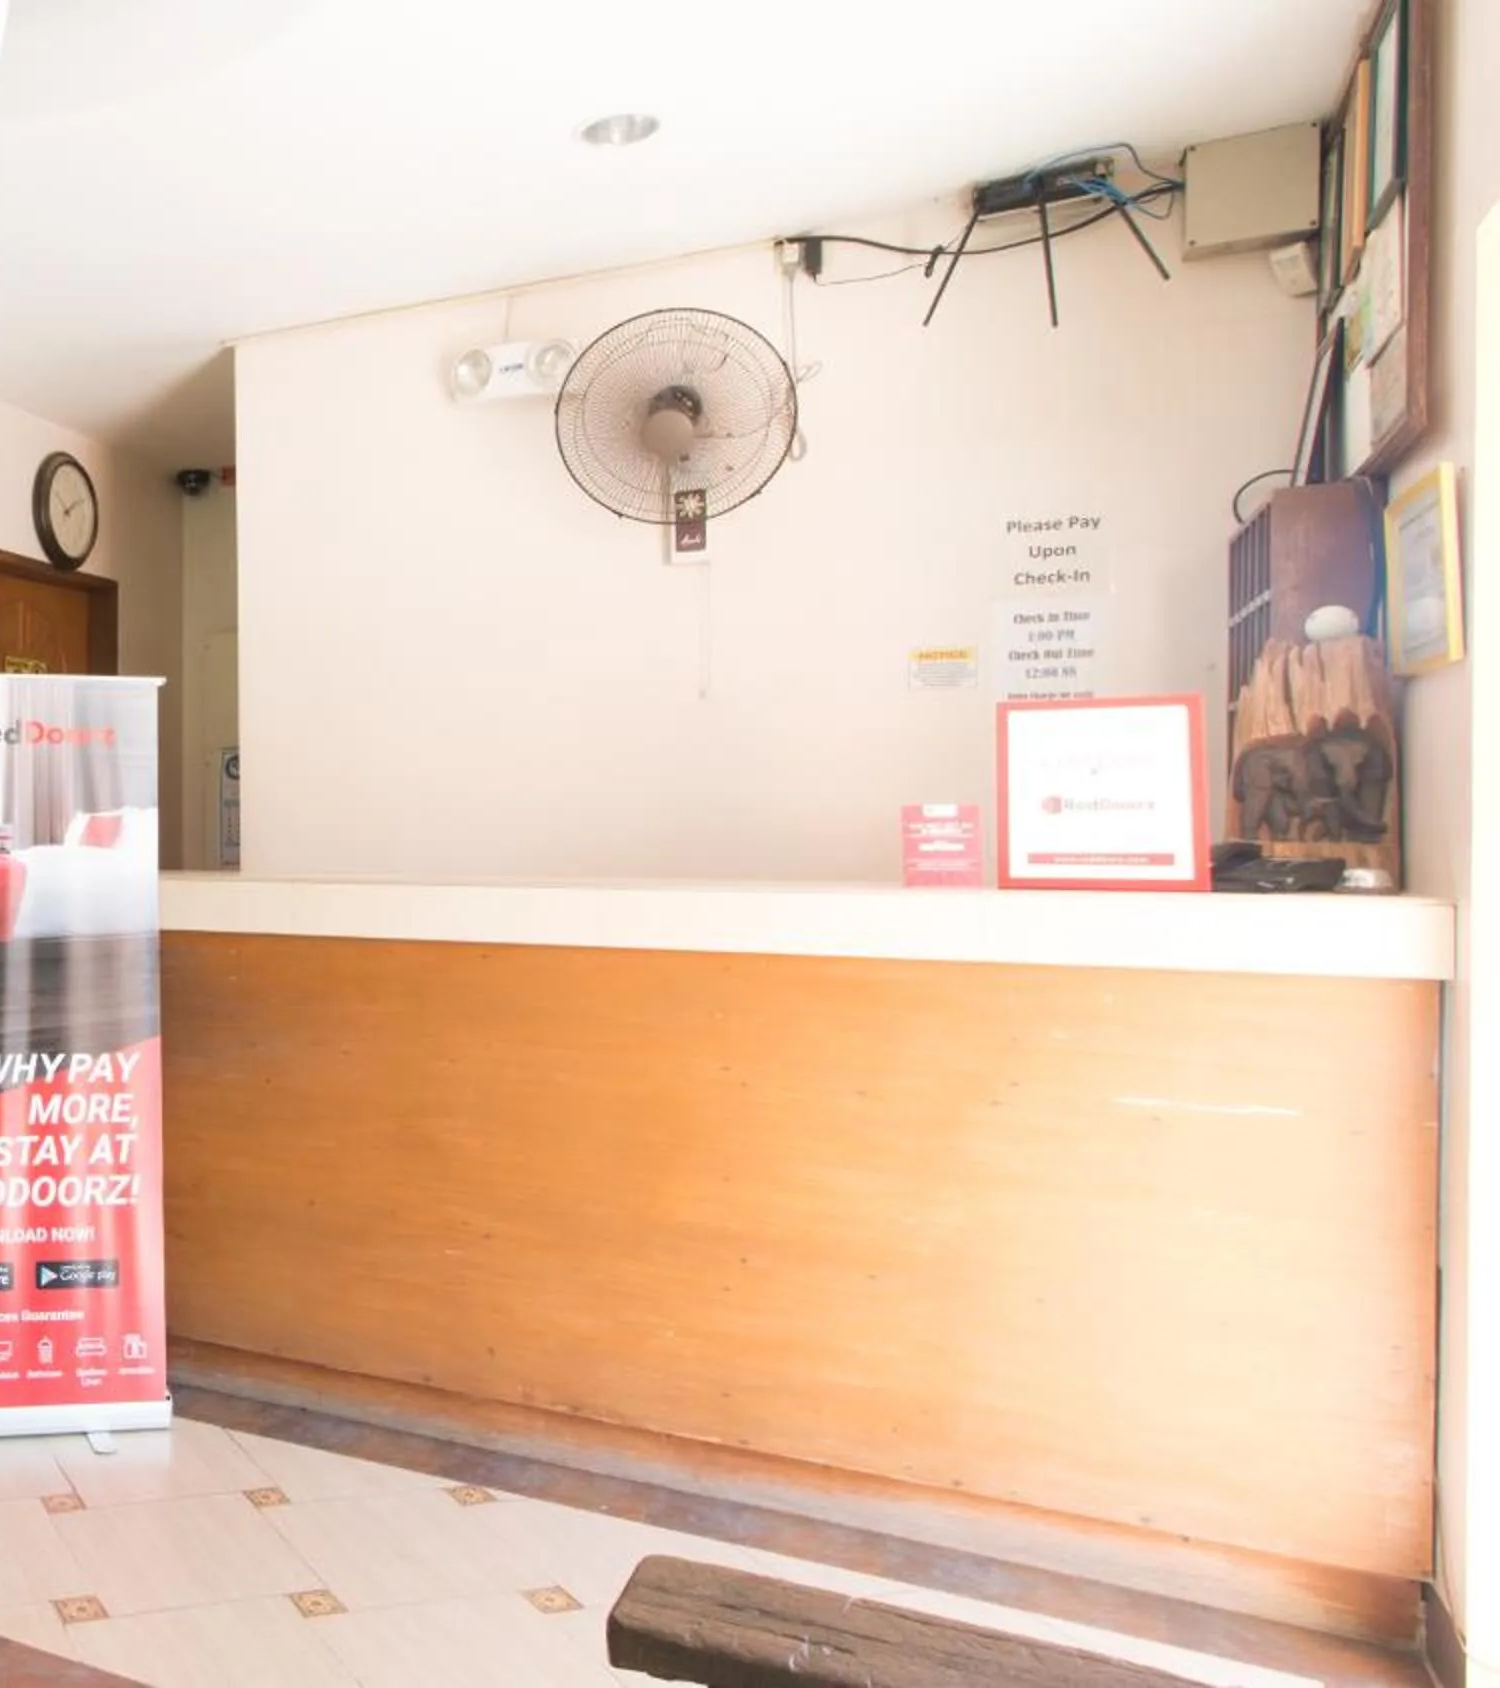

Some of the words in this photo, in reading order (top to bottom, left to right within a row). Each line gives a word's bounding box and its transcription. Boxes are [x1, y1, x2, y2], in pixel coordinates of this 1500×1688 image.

[1006, 518, 1063, 533] Please
[1069, 516, 1101, 530] Pay
[1029, 545, 1077, 560] Upon
[1014, 569, 1091, 585] Check-In
[67, 1053, 140, 1083] PAY
[28, 1093, 139, 1127] MORE,
[89, 1133, 137, 1165] AT
[50, 1226, 95, 1242] NOW!
